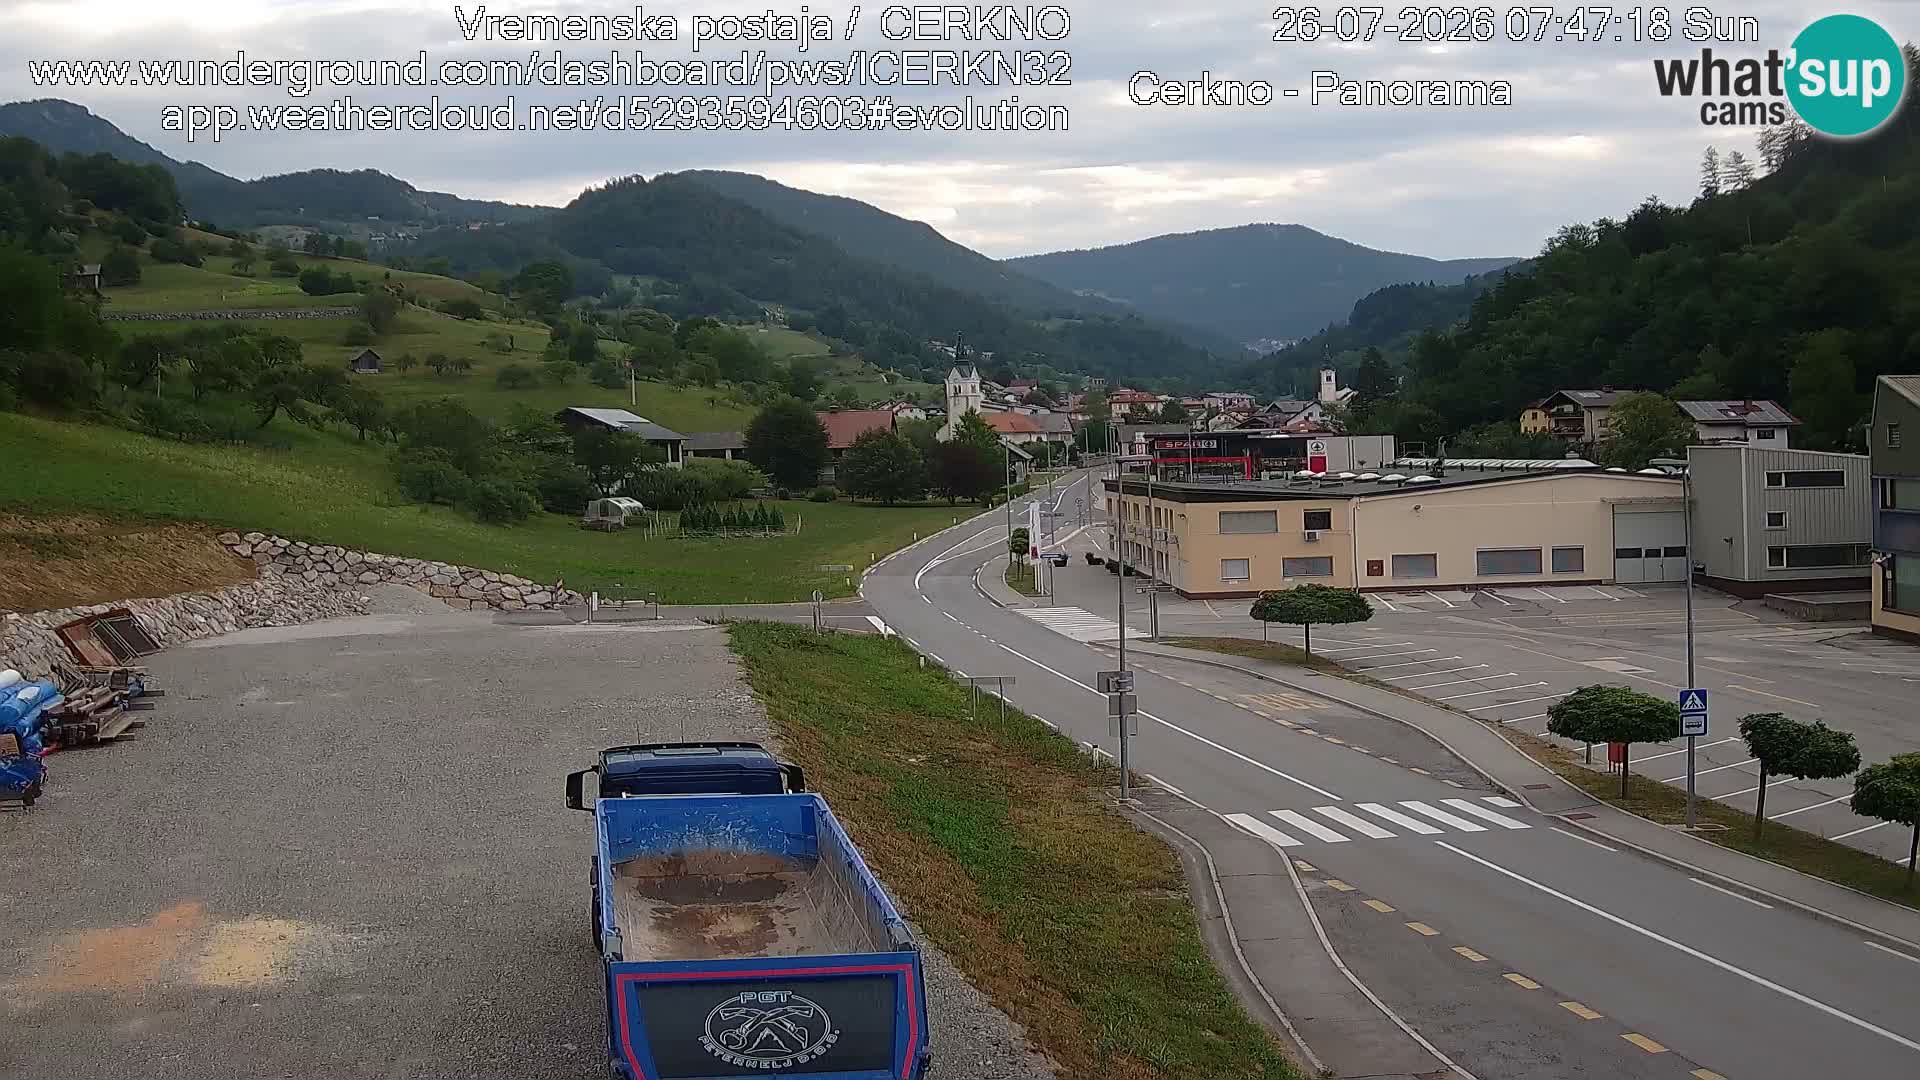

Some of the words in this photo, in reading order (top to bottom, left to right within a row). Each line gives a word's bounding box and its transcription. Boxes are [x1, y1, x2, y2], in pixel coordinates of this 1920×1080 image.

[1165, 440, 1201, 449] SPAR
[740, 990, 792, 1004] PGT
[698, 1035, 793, 1069] PETERNELJ
